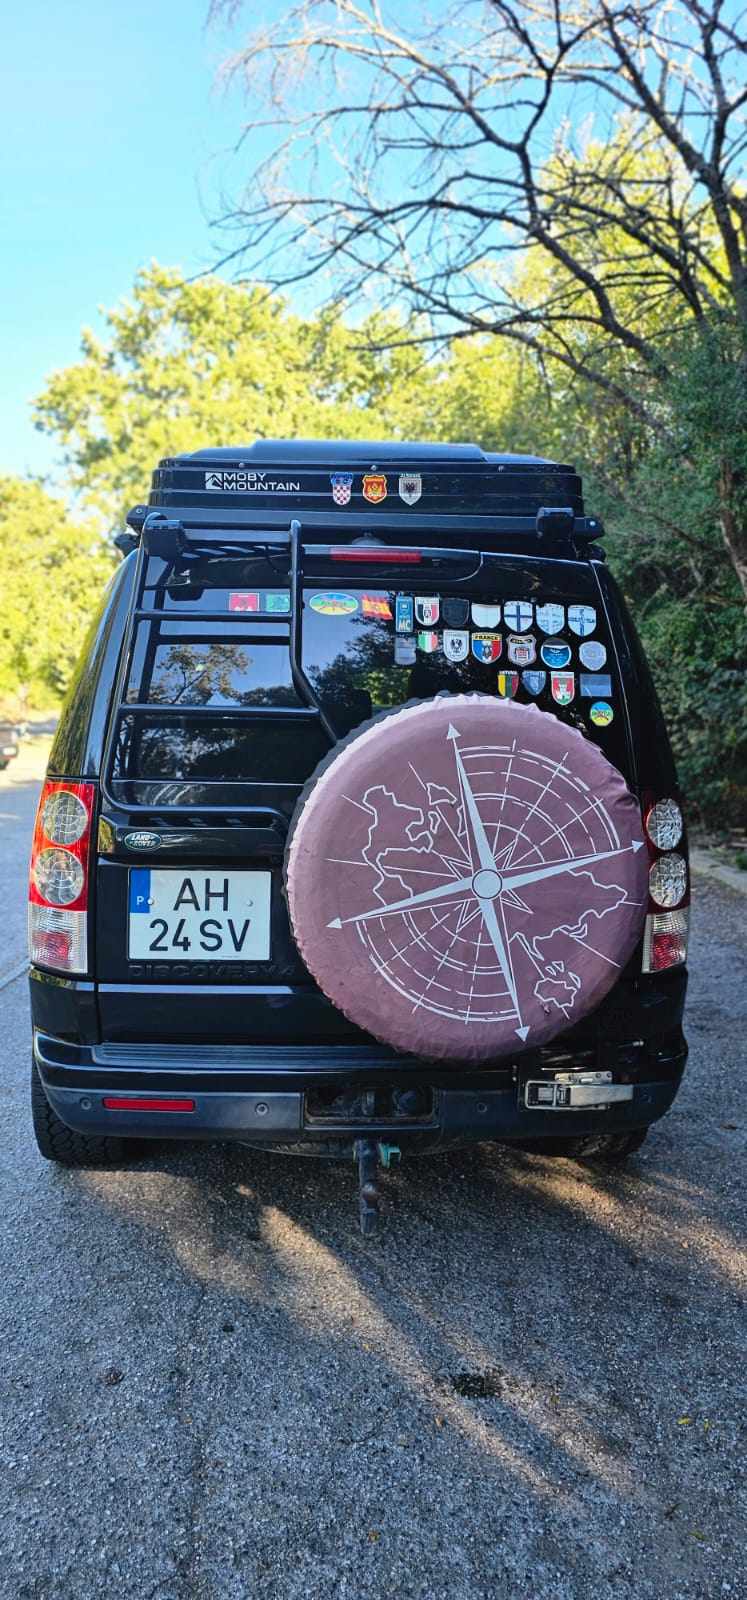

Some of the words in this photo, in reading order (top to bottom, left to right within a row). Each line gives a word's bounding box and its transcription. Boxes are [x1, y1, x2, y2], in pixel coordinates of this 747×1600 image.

[223, 472, 267, 481] MOBY
[223, 482, 300, 491] MOUNTAIN
[131, 833, 153, 841] LAND
[133, 840, 155, 848] ROVER
[173, 878, 229, 912] AH
[136, 895, 145, 906] P
